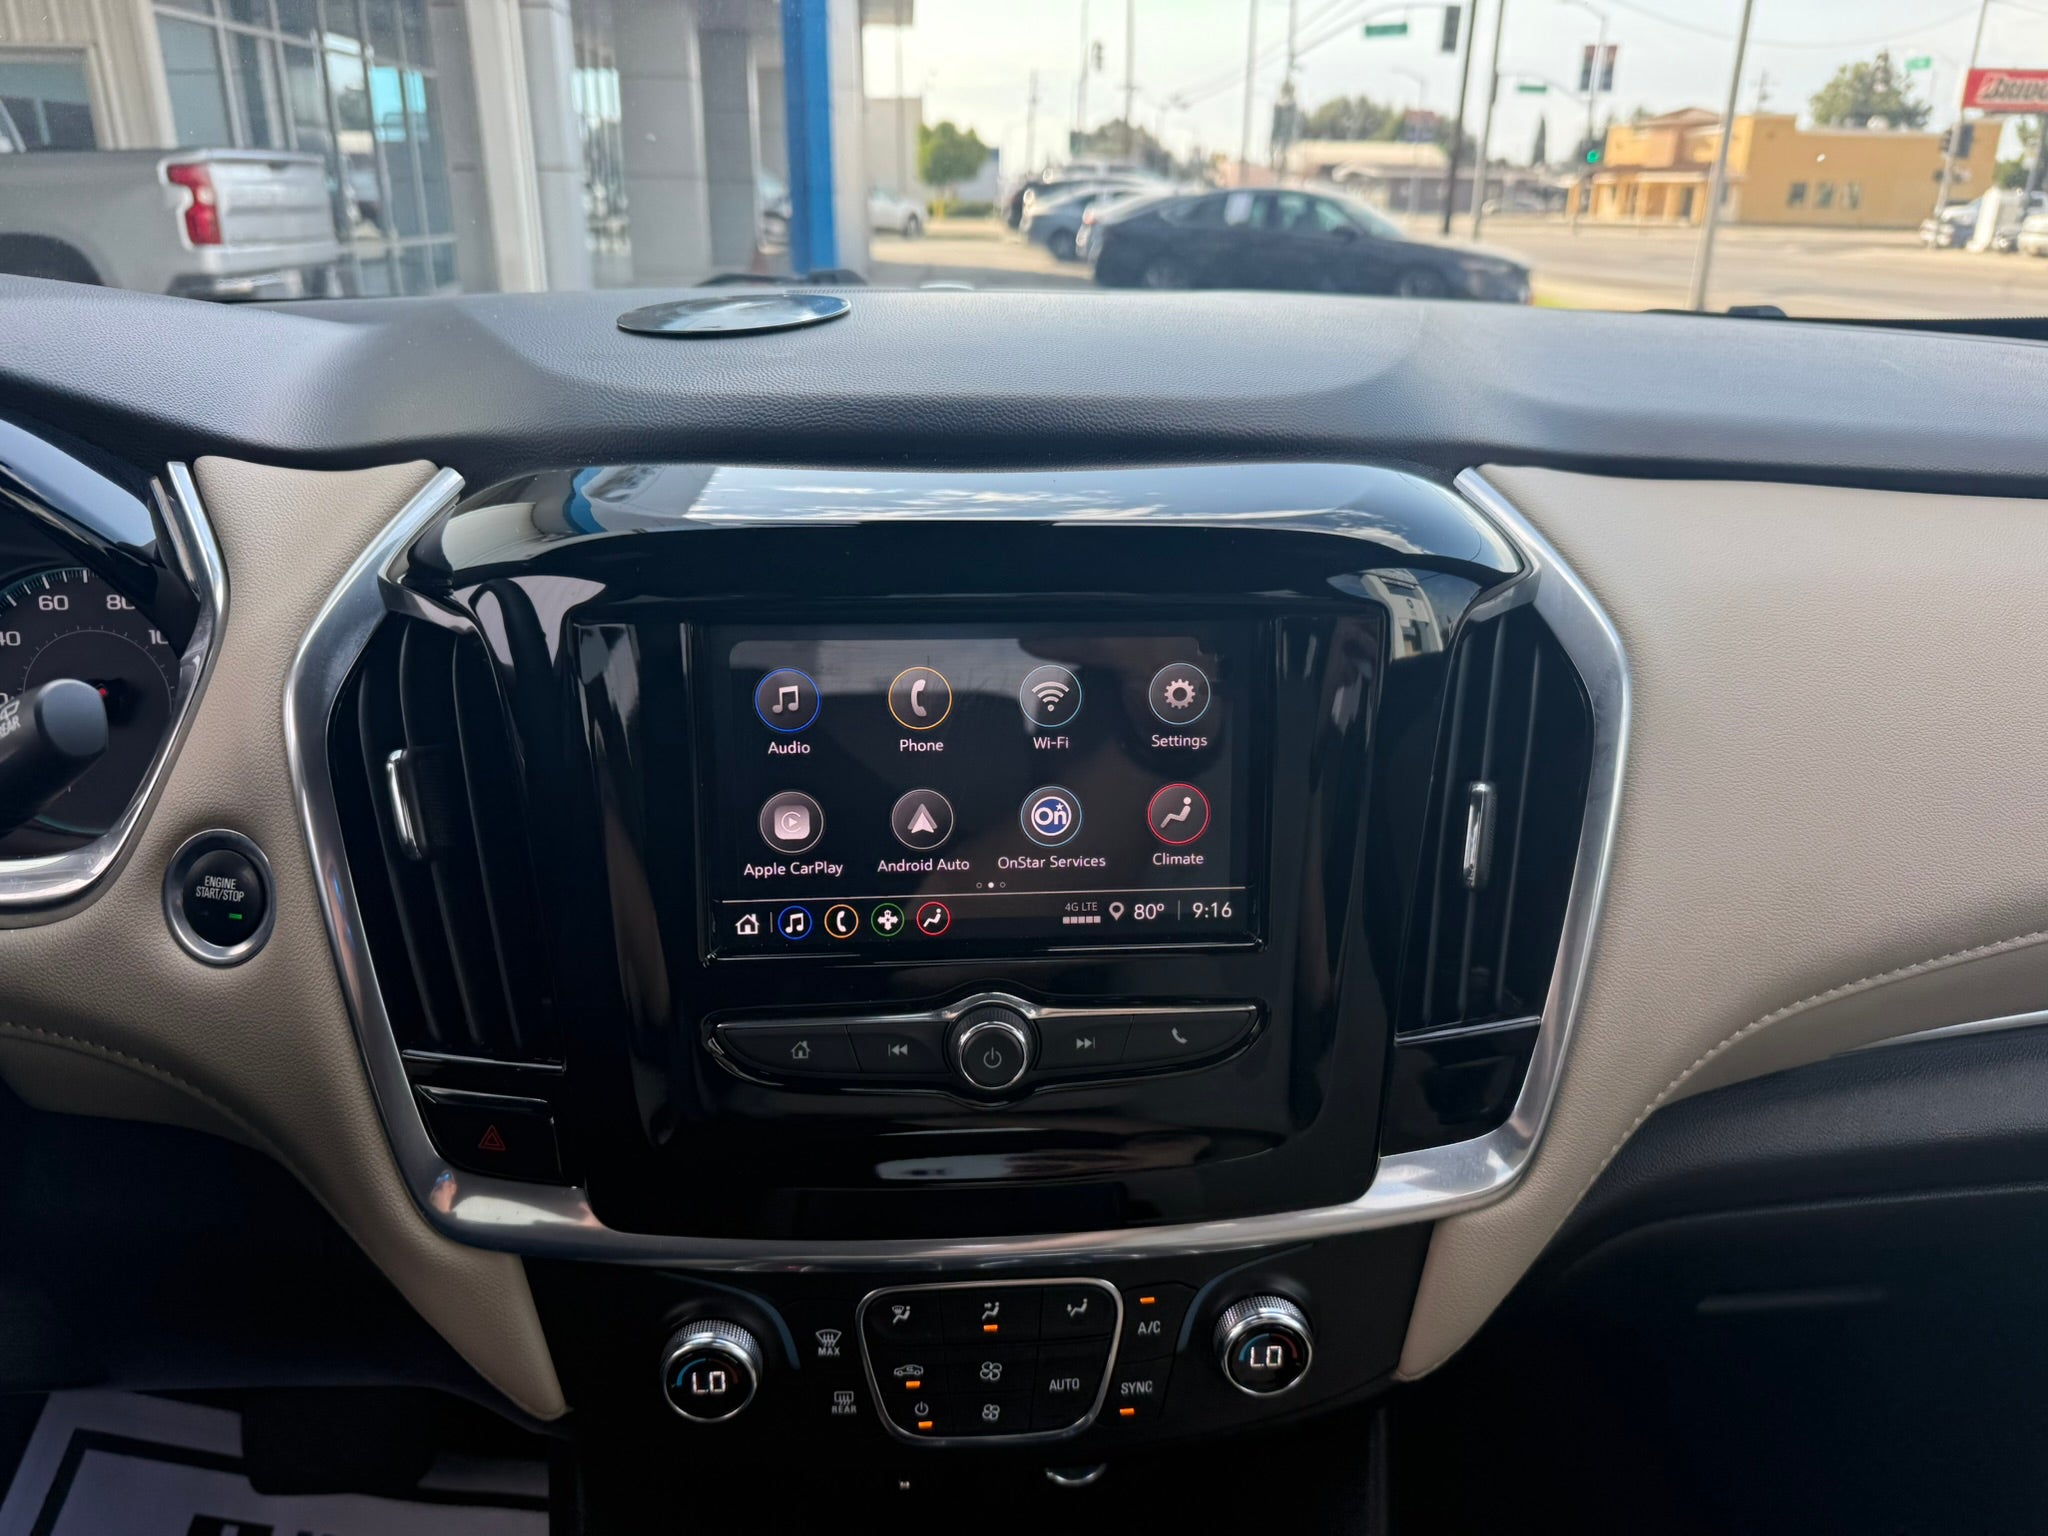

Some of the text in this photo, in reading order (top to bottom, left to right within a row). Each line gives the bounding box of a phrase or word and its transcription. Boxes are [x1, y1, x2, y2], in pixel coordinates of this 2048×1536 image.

[38, 595, 69, 611] 60
[0, 714, 21, 738] EAR
[768, 741, 811, 754] Audio
[900, 739, 944, 752] Phone
[1033, 736, 1069, 749] Wi-Fi
[1151, 734, 1208, 750] Settings
[877, 858, 970, 873] Android Auto
[998, 855, 1106, 869] OnStar Services
[1152, 853, 1205, 866] Climate
[744, 861, 843, 878] Apple CarPlay
[204, 875, 237, 890] ENGINE
[195, 885, 245, 902] START/STOP
[1064, 901, 1098, 912] 4G LTE
[1192, 902, 1232, 918] 9:16
[1138, 1320, 1161, 1335] A/C
[817, 1346, 840, 1357] MAX
[1250, 1345, 1283, 1367] LO
[692, 1370, 727, 1394] LO
[1049, 1377, 1080, 1391] AUTO
[1120, 1380, 1153, 1395] SYNC
[831, 1404, 857, 1414] REAR
